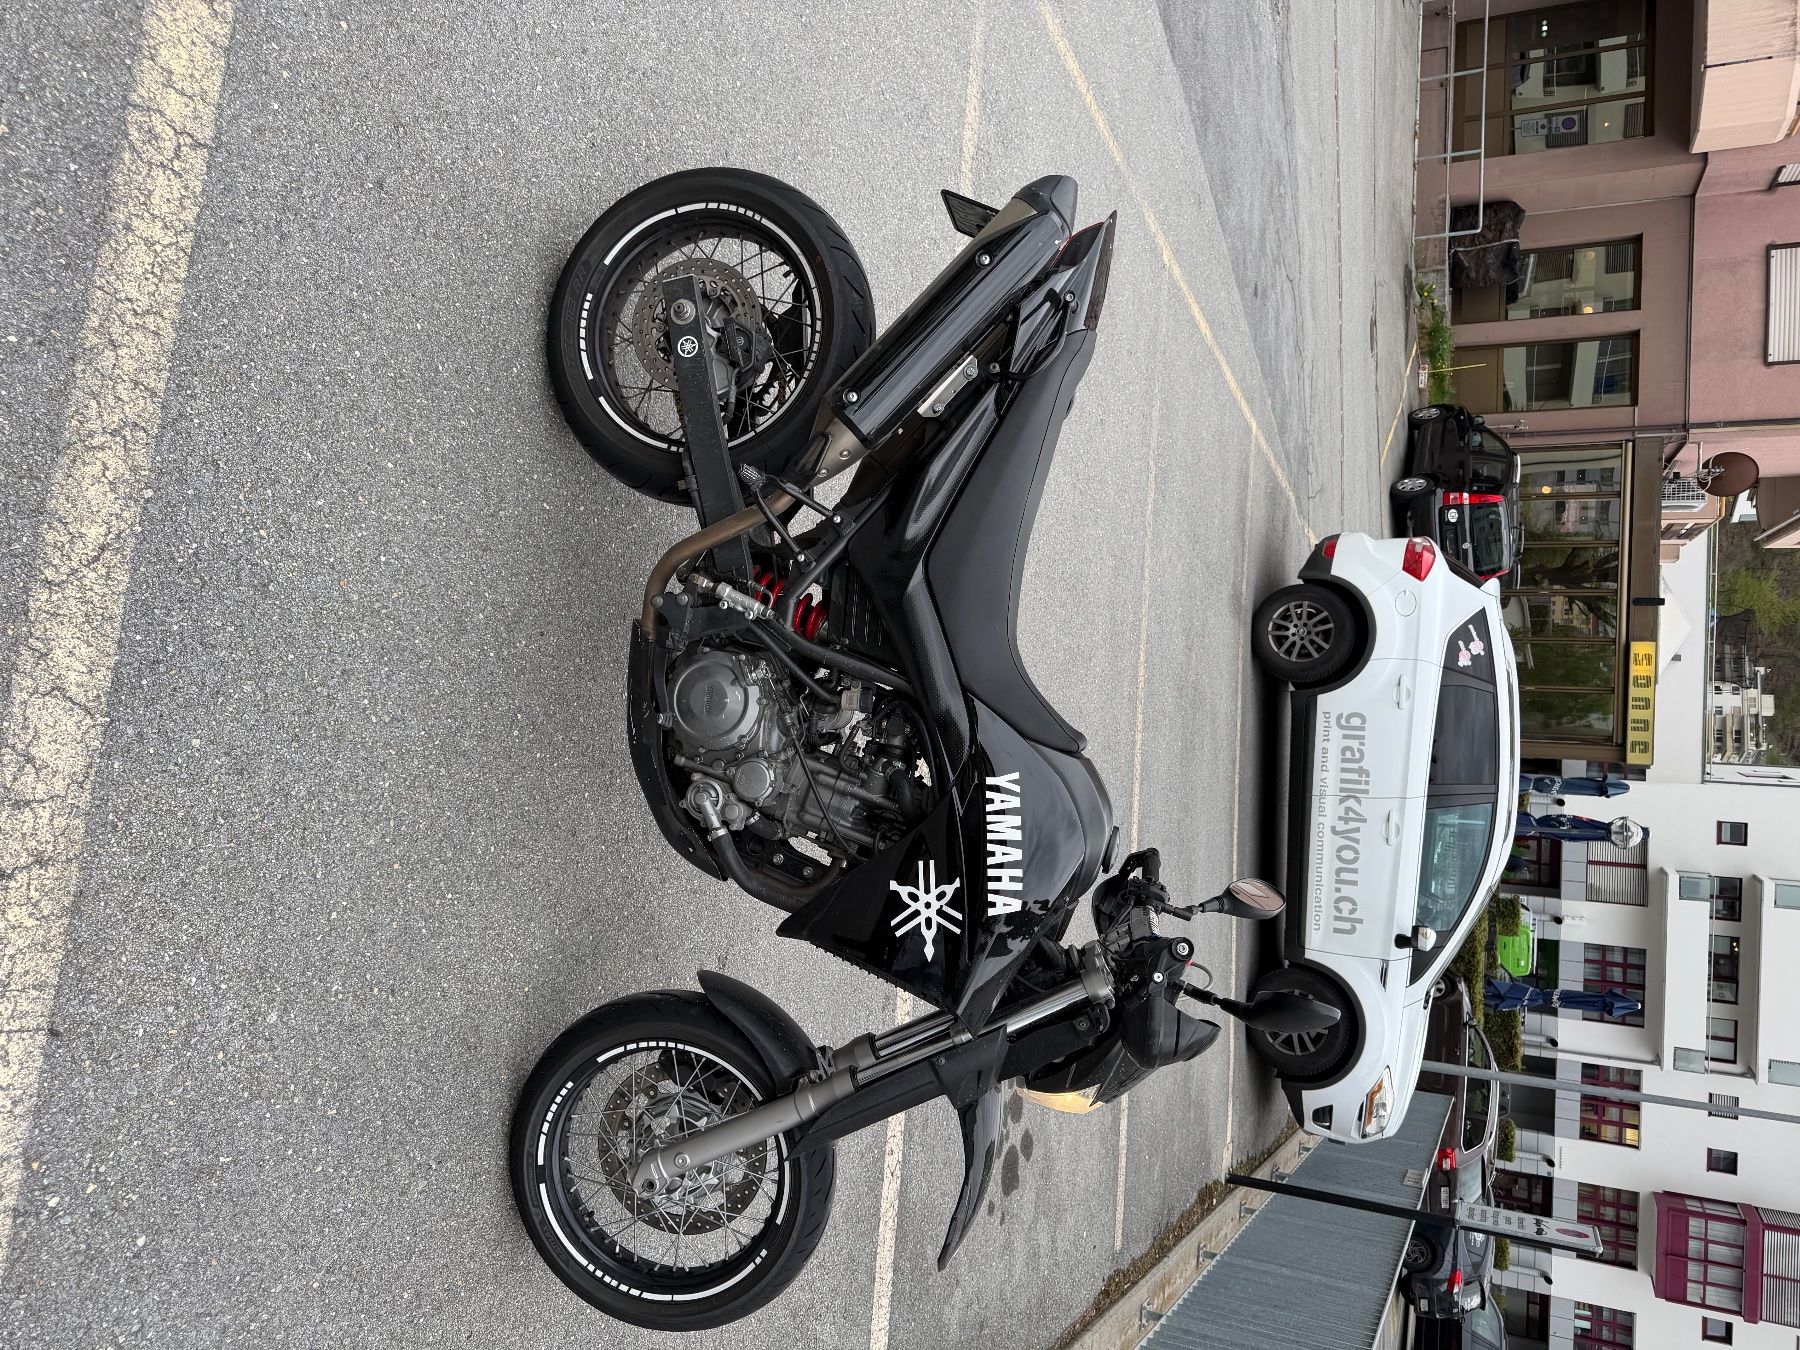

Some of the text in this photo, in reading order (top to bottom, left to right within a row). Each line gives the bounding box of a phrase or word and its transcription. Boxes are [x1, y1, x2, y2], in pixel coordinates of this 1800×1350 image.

[1449, 512, 1456, 520] CH
[985, 772, 1022, 916] YAMAHA
[1313, 712, 1332, 932] print and visual communication
[1330, 712, 1370, 936] grafik4you.ch
